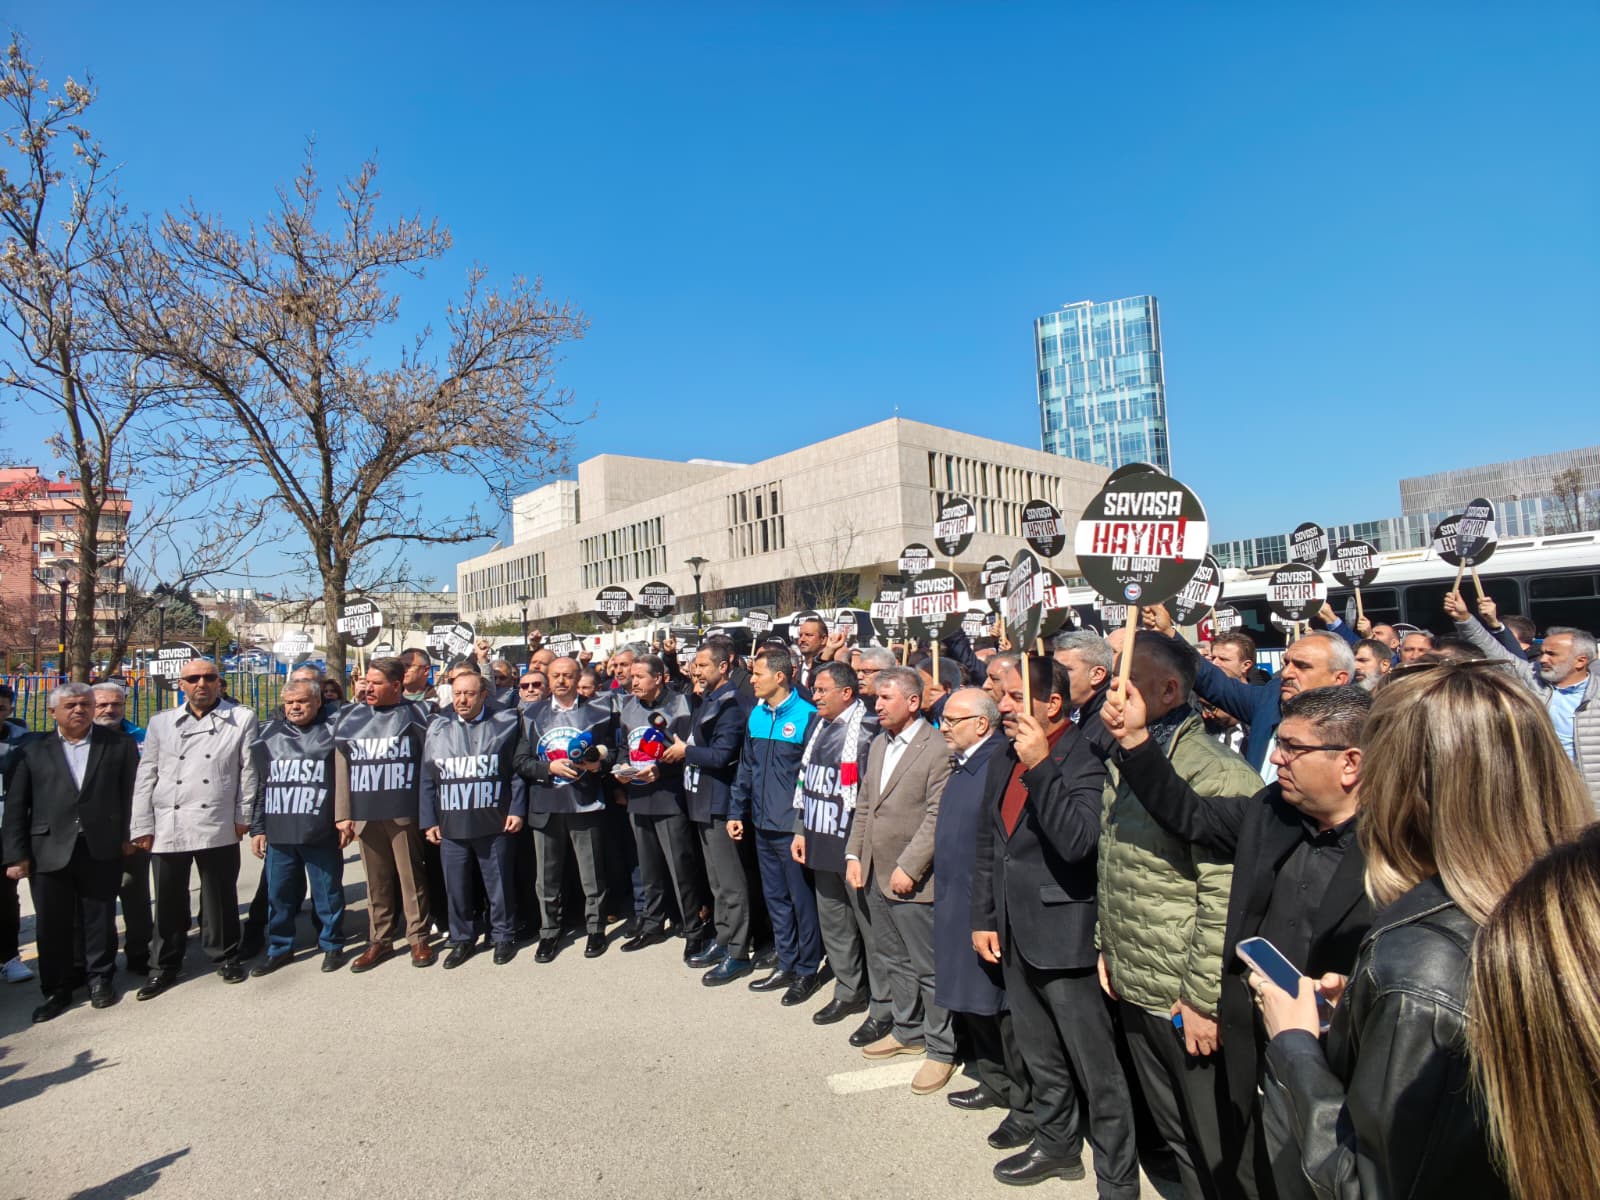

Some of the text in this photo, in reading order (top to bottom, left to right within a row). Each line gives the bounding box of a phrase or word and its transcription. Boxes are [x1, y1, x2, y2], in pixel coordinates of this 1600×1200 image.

[1103, 491, 1183, 519] SAVAŞA
[939, 515, 969, 537] HAYIR!
[1027, 515, 1059, 537] HAYIR!
[1440, 521, 1459, 536] SAV
[1092, 516, 1187, 564] HAYIR!
[1112, 556, 1160, 572] NO WAR!
[1336, 552, 1375, 572] HAYIR!
[914, 576, 954, 594] SAVAŞA
[1276, 570, 1313, 584] SAVAŞA
[881, 590, 901, 602] SAVA
[1274, 582, 1316, 602] HAYIR!
[600, 600, 629, 611] HAYIR!
[877, 604, 898, 617] HAY
[912, 590, 958, 616] HAYIR!
[158, 648, 191, 659] SAVAŞA
[157, 659, 190, 675] HAYI
[350, 736, 411, 762] SAVAŞA
[350, 763, 415, 792] HAYIR!
[434, 754, 499, 780] SAVAŞA
[265, 786, 328, 815] HAYIR!
[440, 781, 502, 811] HAYIR!
[803, 795, 849, 839] YIR!
